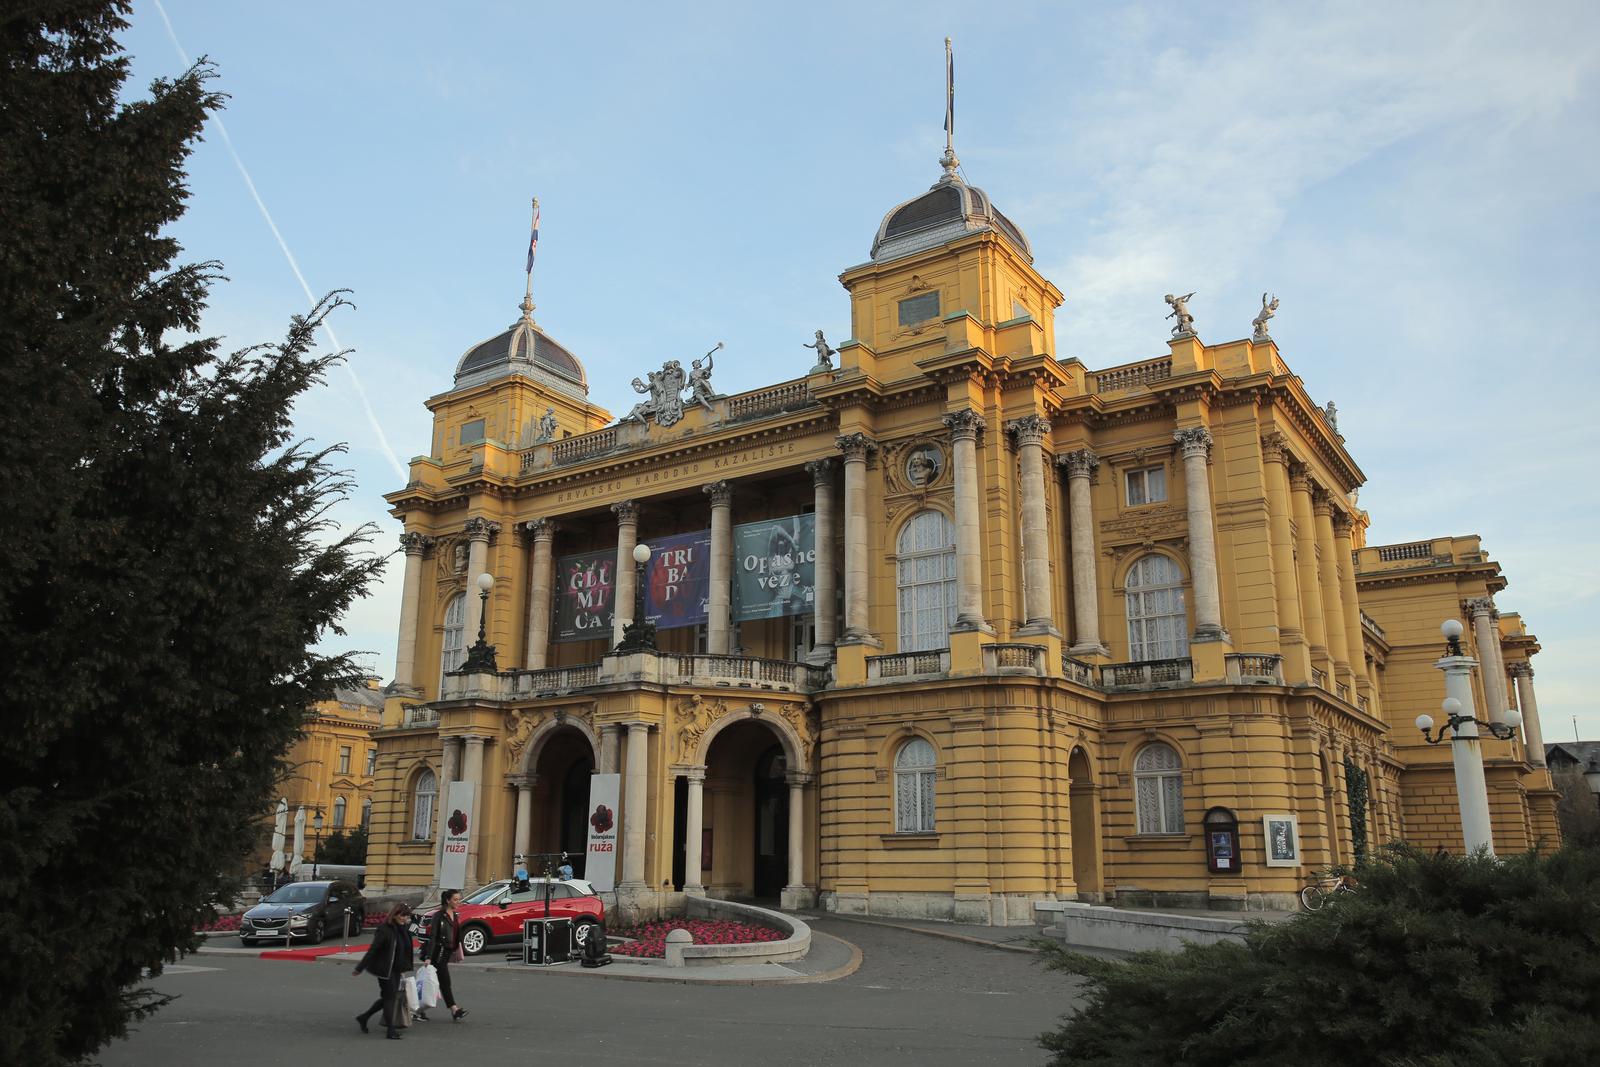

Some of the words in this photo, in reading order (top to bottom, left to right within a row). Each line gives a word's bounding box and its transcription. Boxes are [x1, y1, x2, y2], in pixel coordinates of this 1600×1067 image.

[558, 482, 621, 502] HRVATSKO
[635, 464, 699, 486] NARODNO
[743, 549, 816, 574] Opasne
[570, 568, 610, 590] GLU
[758, 572, 801, 589] veze
[576, 589, 604, 609] MI
[575, 611, 603, 629] CA
[445, 842, 466, 853] ruža
[590, 840, 613, 852] ruža
